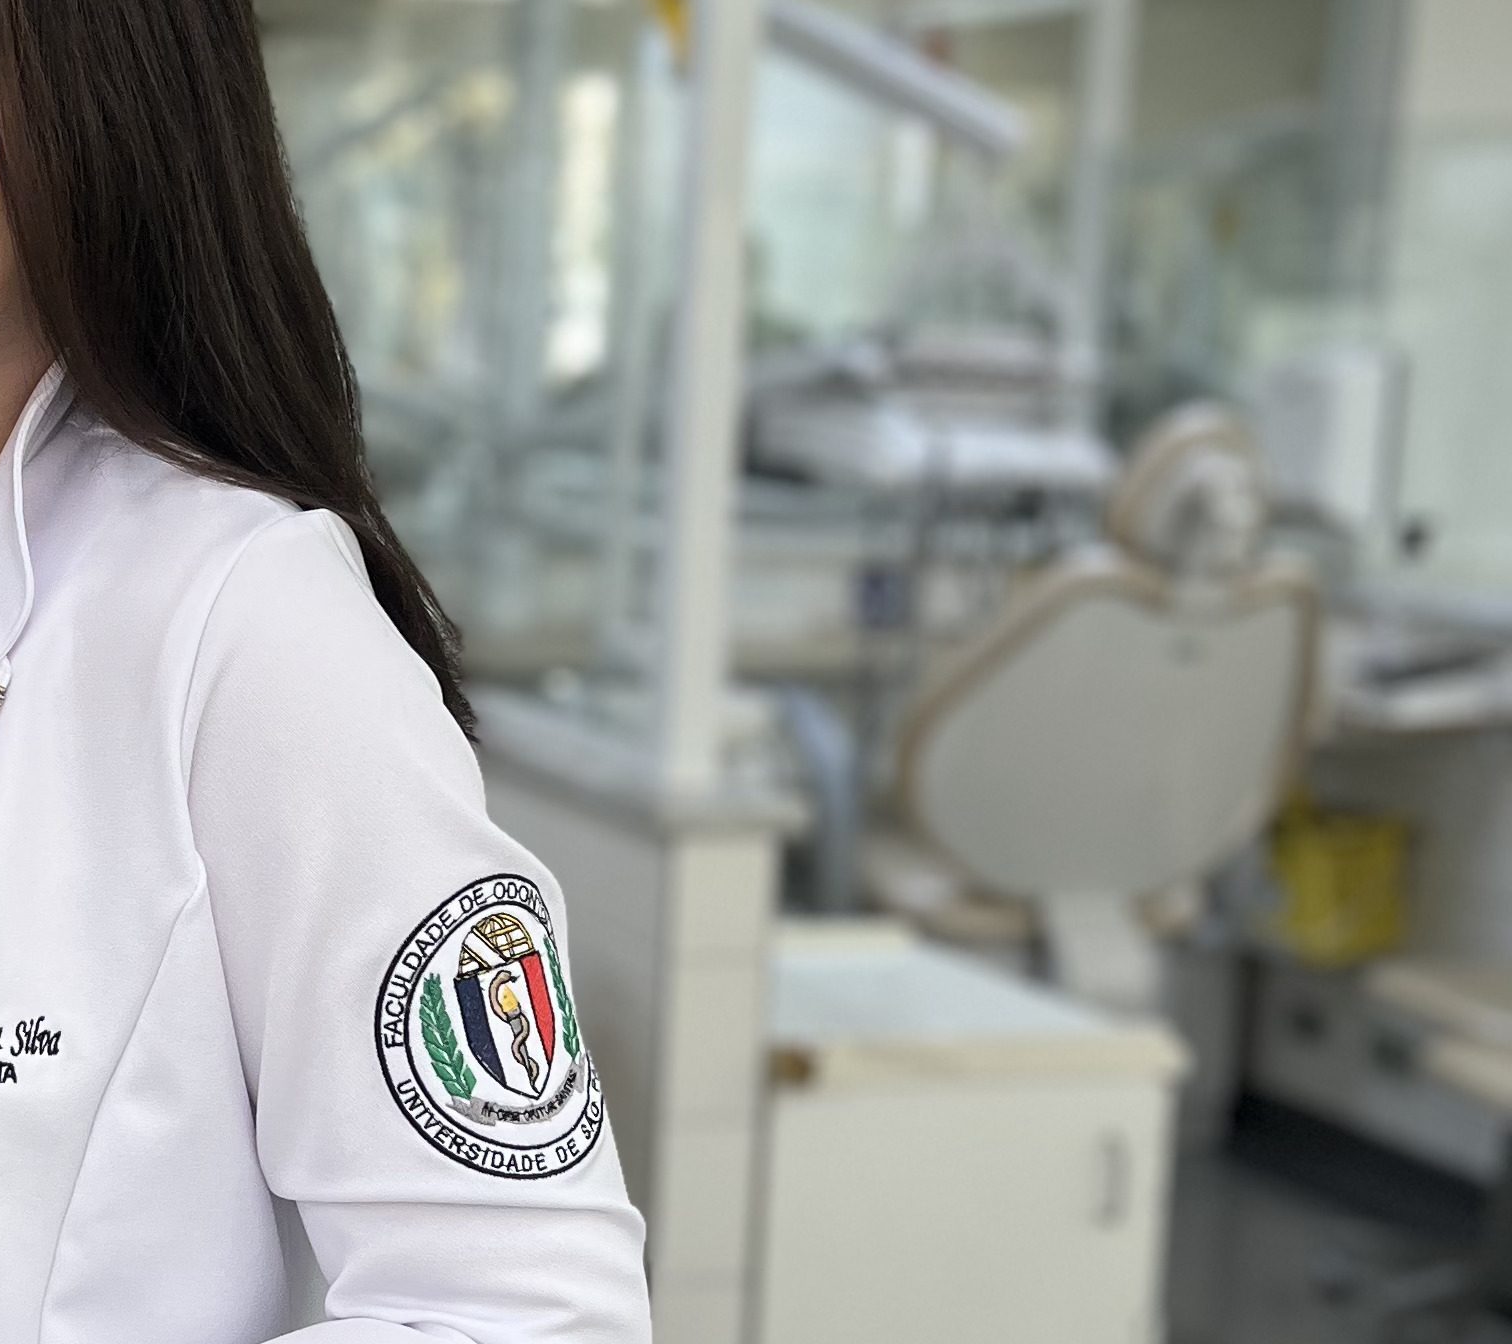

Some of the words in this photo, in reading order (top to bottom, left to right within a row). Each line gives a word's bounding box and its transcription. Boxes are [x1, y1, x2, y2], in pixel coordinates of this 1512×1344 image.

[384, 909, 452, 1048] FACULDADE
[459, 887, 486, 913] DE
[10, 1016, 61, 1057] Silva
[397, 1079, 547, 1172] UNIVERSIDADE
[555, 1138, 580, 1164] DE
